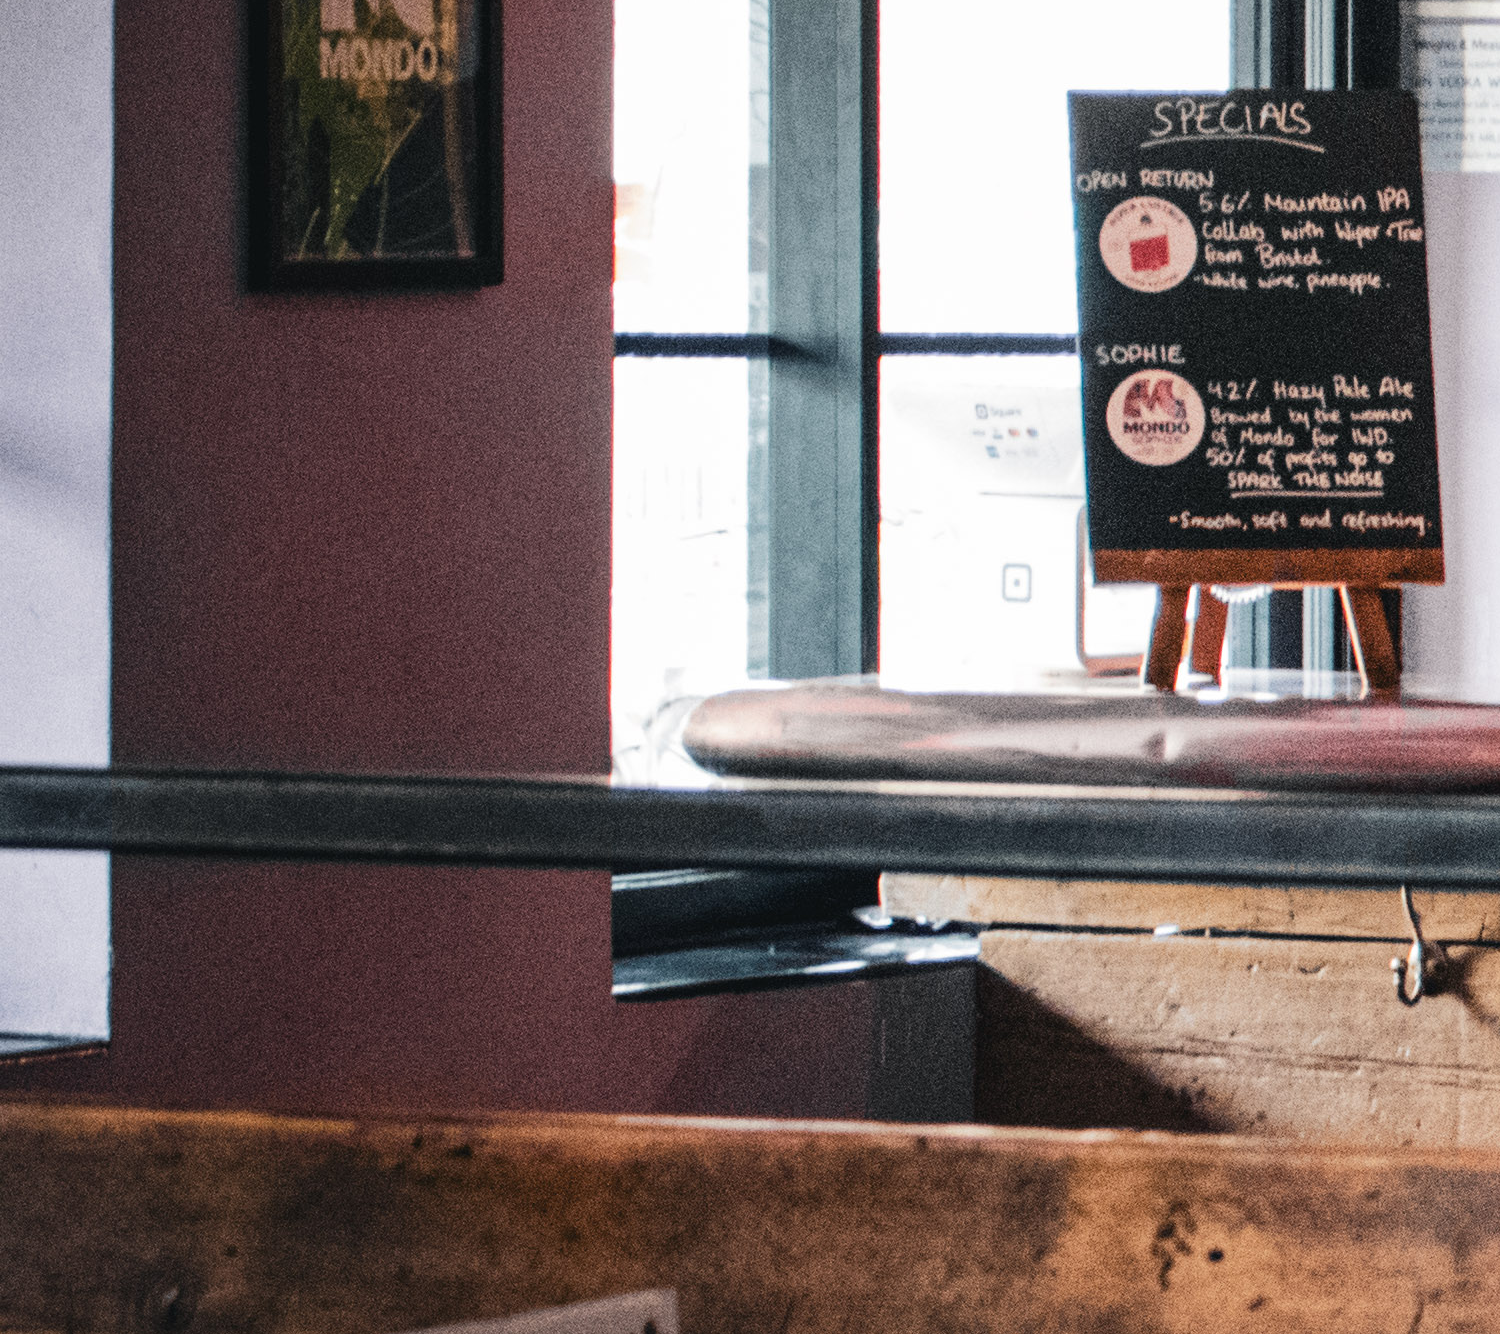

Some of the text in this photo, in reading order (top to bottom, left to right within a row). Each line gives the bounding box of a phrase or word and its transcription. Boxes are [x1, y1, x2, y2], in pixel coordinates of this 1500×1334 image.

[320, 38, 437, 80] MONDO
[1149, 98, 1311, 137] SPECIALS
[1076, 168, 1214, 193] OPEN RETURN
[1264, 188, 1410, 213] Mountain IPA
[1097, 344, 1185, 365] SOPHIE
[1123, 420, 1190, 435] MONDO
